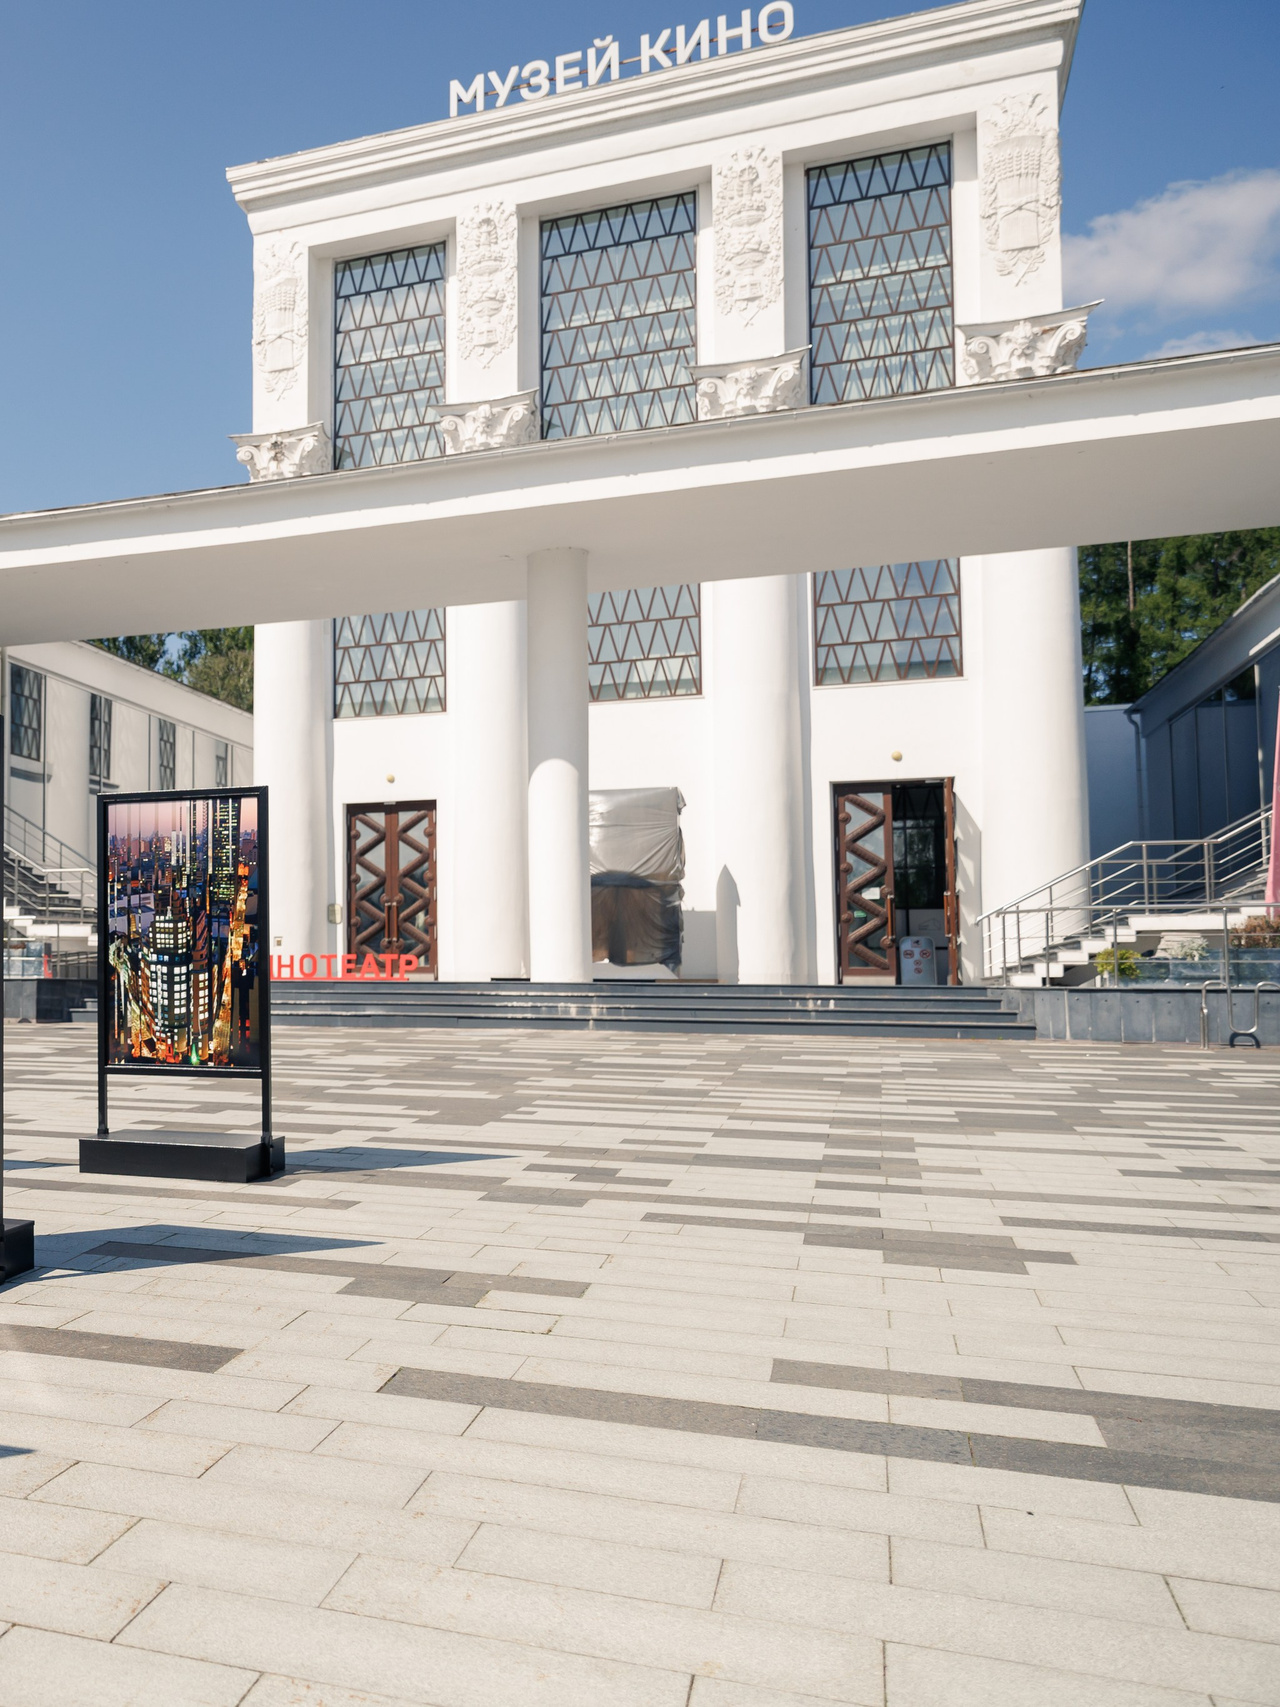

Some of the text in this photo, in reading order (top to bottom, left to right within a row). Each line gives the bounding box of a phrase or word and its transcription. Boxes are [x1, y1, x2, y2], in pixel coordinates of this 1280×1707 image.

[449, 0, 794, 117] МУЗЕЙ КИНО
[270, 953, 419, 979] НОТЕАТР
